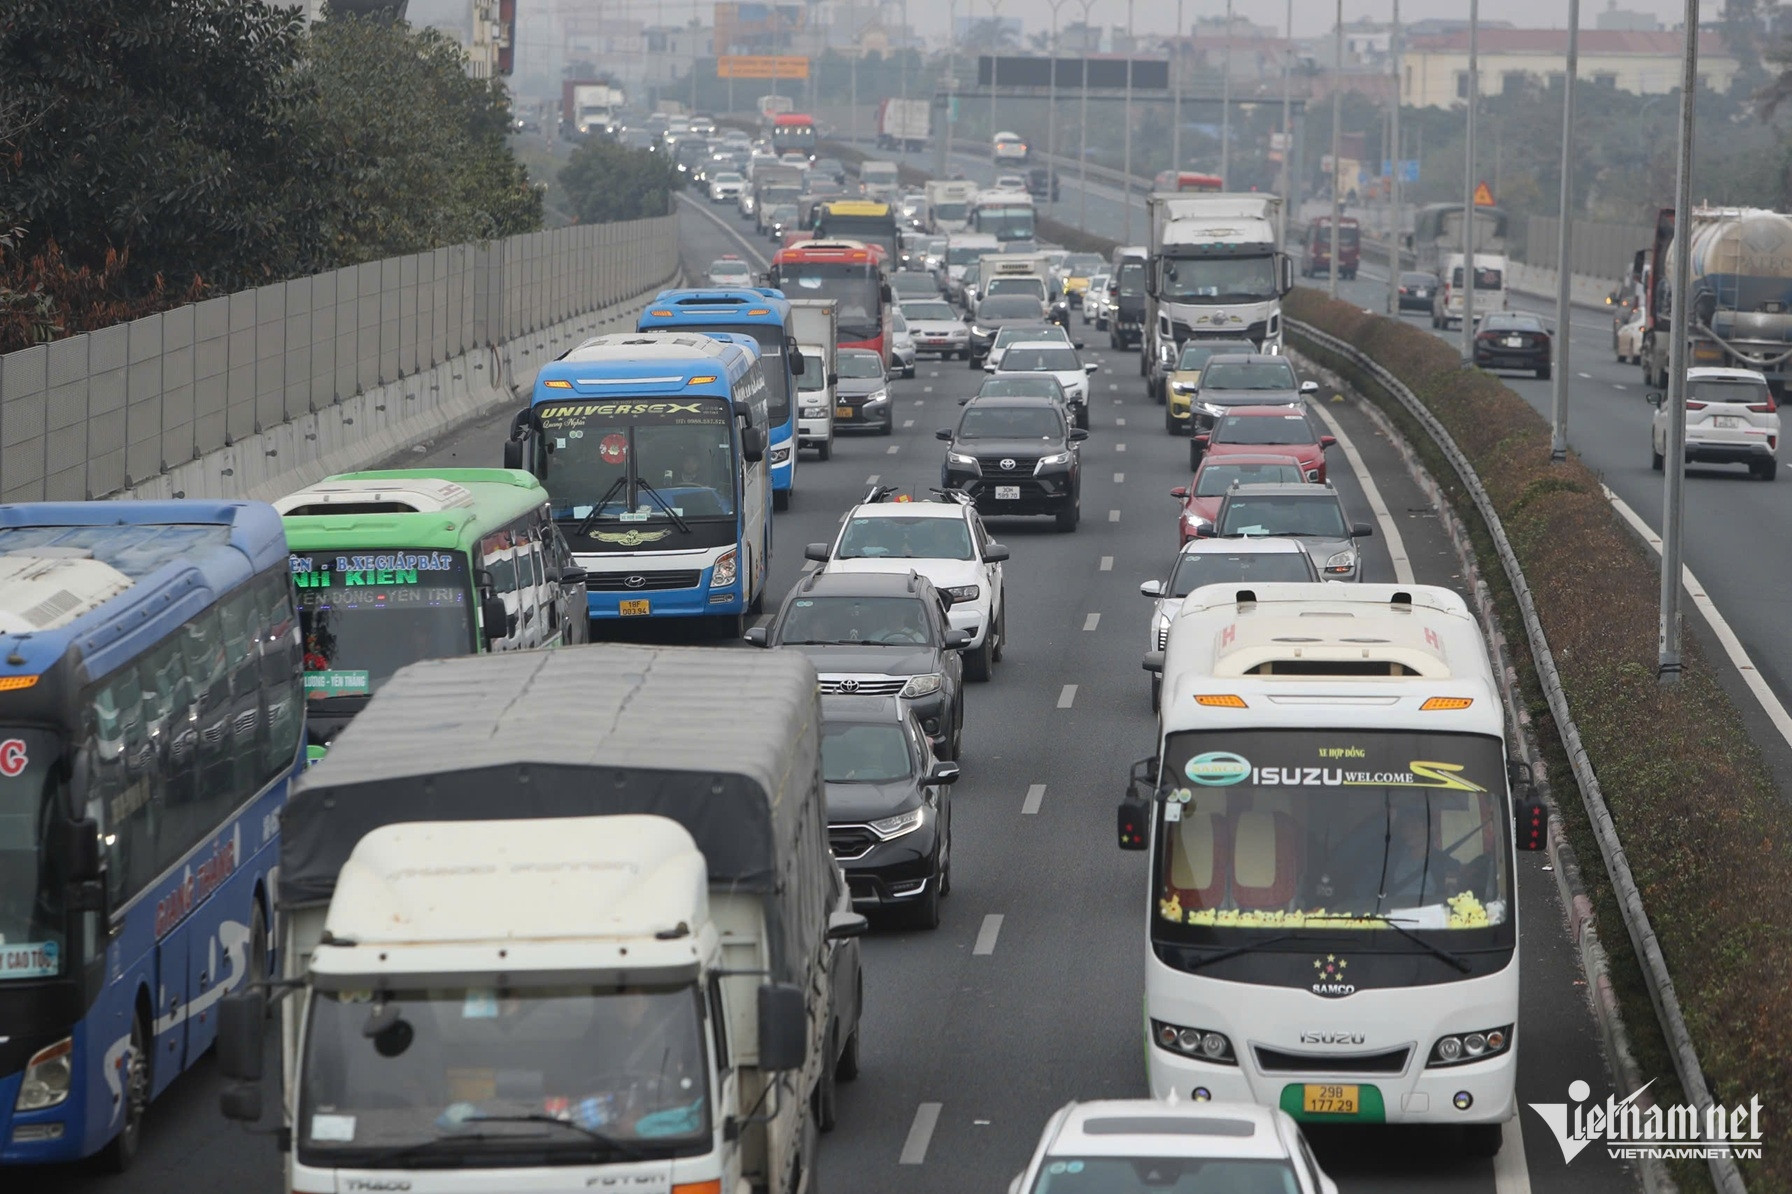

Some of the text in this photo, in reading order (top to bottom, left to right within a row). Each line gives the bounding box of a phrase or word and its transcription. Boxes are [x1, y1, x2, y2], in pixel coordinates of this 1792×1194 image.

[1253, 767, 1414, 785] ISUZU WELCOME
[1312, 983, 1355, 995] SAMCO
[1300, 1030, 1366, 1045] ISUZU
[1320, 1086, 1343, 1099] 29B
[1311, 1099, 1353, 1112] 177.29
